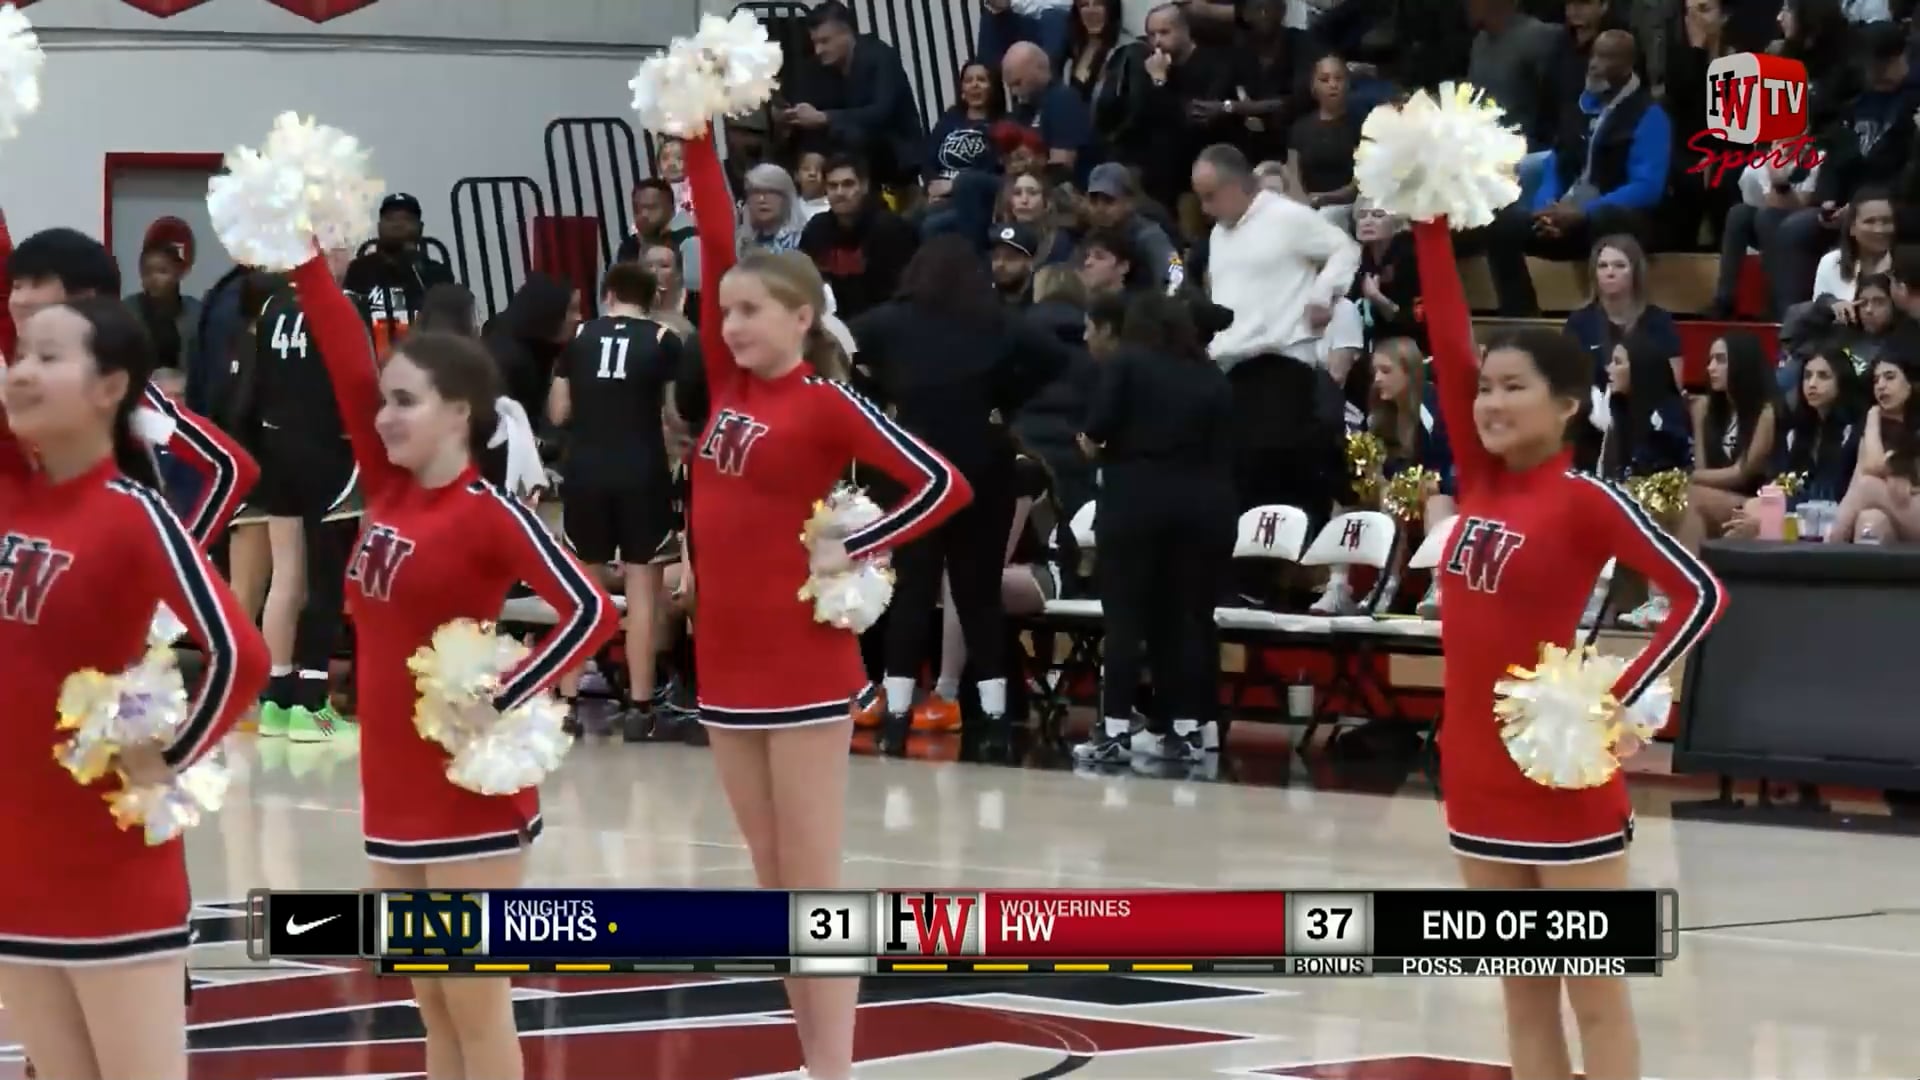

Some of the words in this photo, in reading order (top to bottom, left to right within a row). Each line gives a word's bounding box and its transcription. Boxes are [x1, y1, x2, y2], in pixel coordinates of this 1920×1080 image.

[271, 312, 308, 359] 44
[596, 336, 630, 379] 11
[1446, 516, 1525, 593] HW
